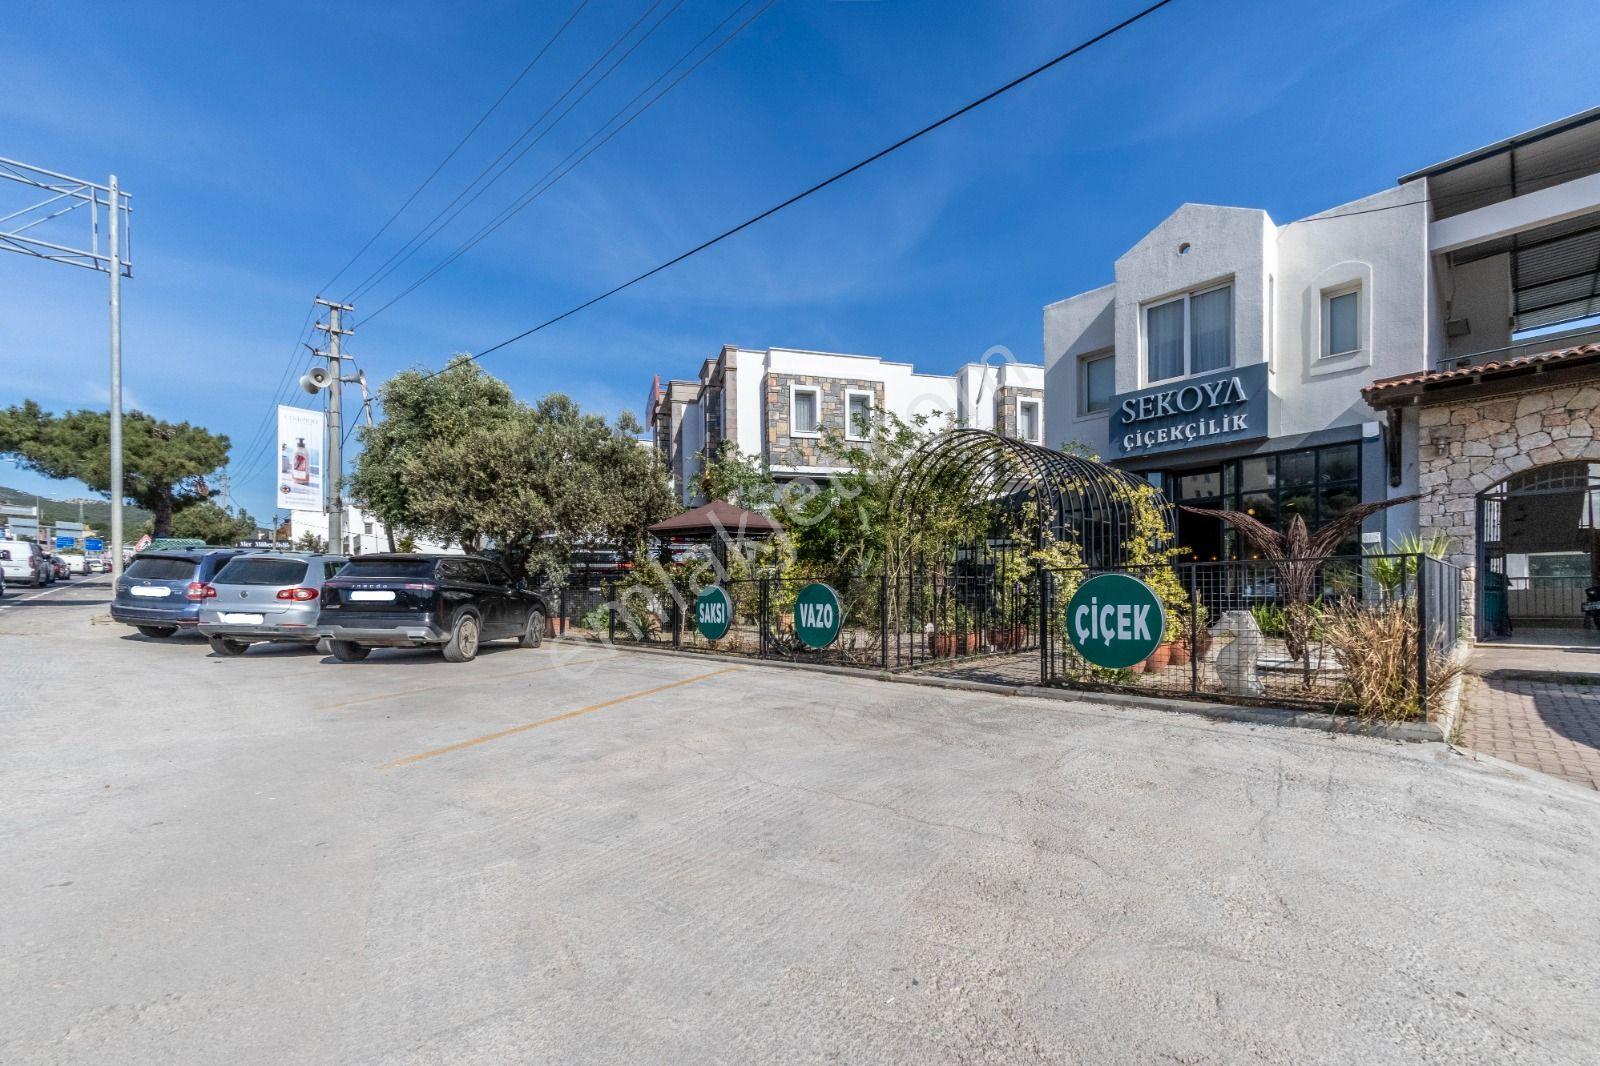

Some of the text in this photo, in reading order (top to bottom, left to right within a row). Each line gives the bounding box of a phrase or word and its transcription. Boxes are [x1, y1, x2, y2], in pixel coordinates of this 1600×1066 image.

[1121, 376, 1249, 424] SEKOYA
[1123, 413, 1249, 451] ÇİÇEKÇİLİK
[699, 602, 725, 624] SAKSI
[800, 603, 833, 629] VAZO
[1075, 597, 1151, 646] ÇİÇEK
